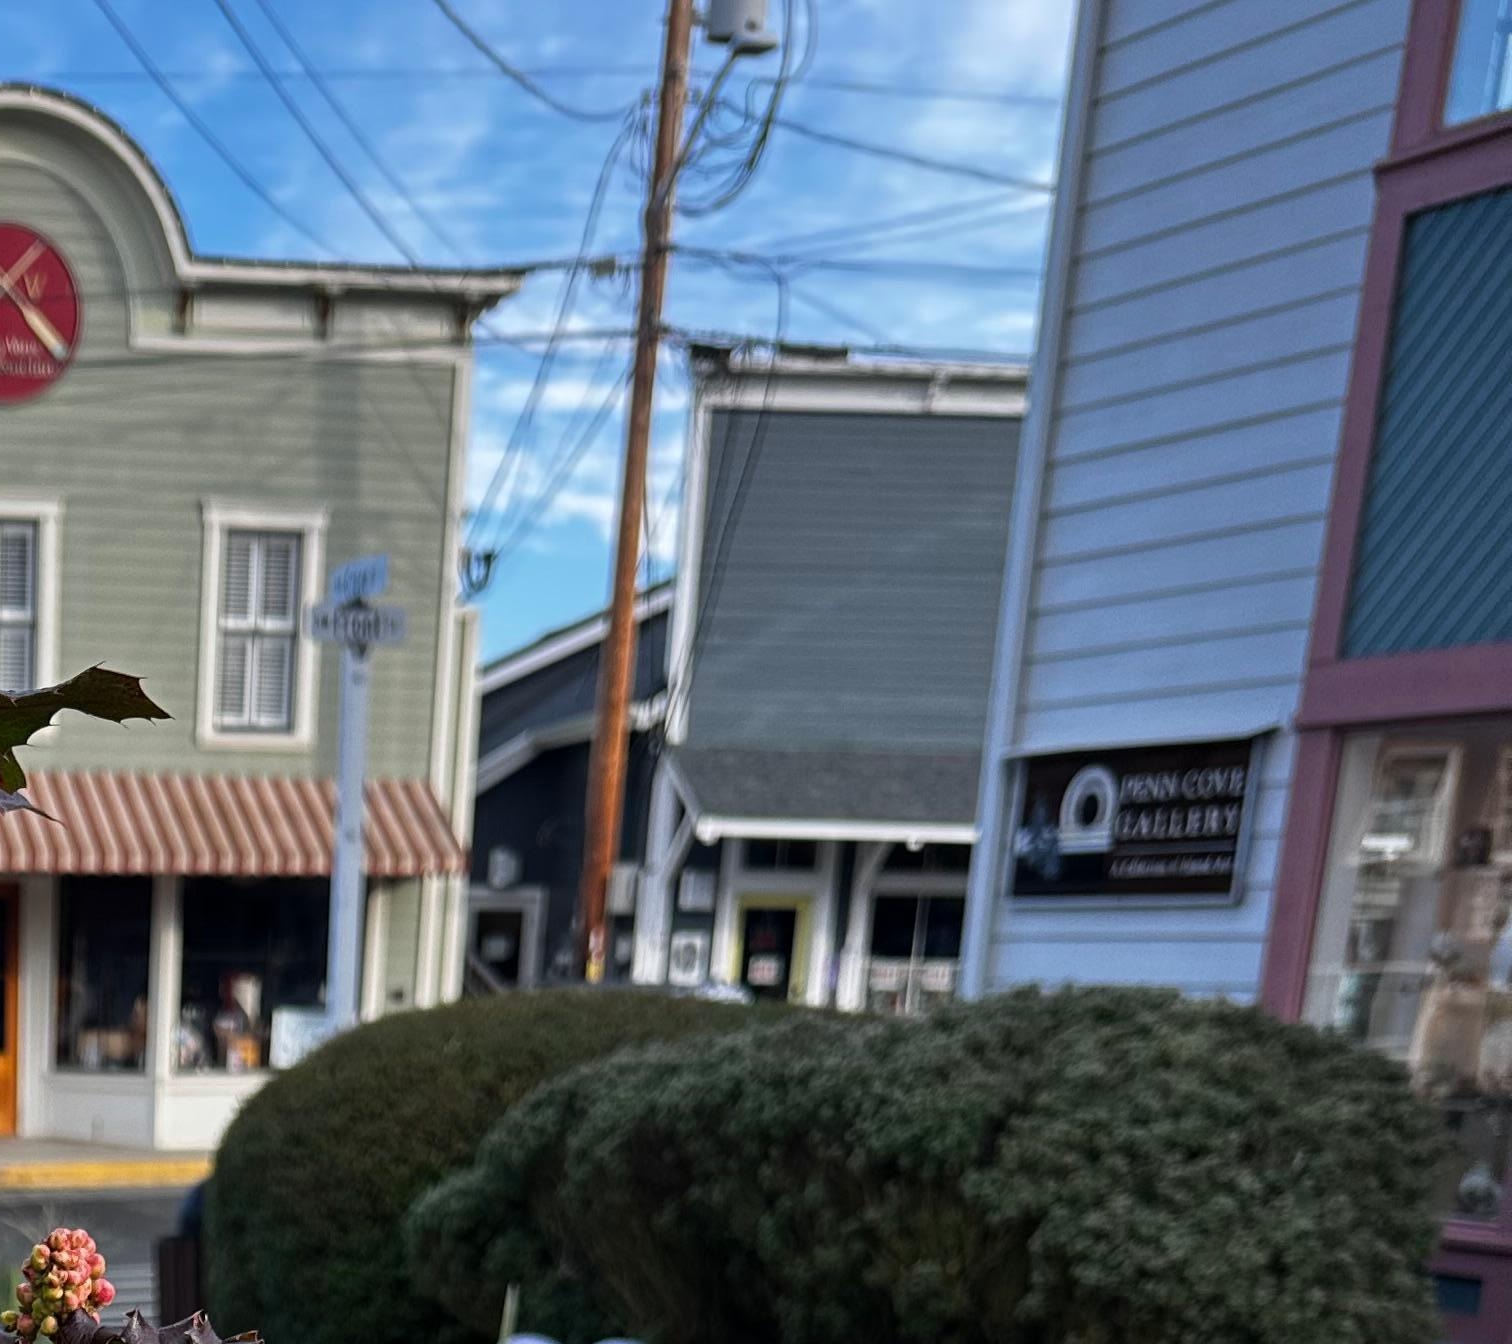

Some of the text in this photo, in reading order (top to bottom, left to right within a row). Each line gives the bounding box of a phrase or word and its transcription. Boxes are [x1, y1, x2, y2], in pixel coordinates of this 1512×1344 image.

[1120, 767, 1245, 803] PENN COVE
[1114, 803, 1239, 841] GALLERY
